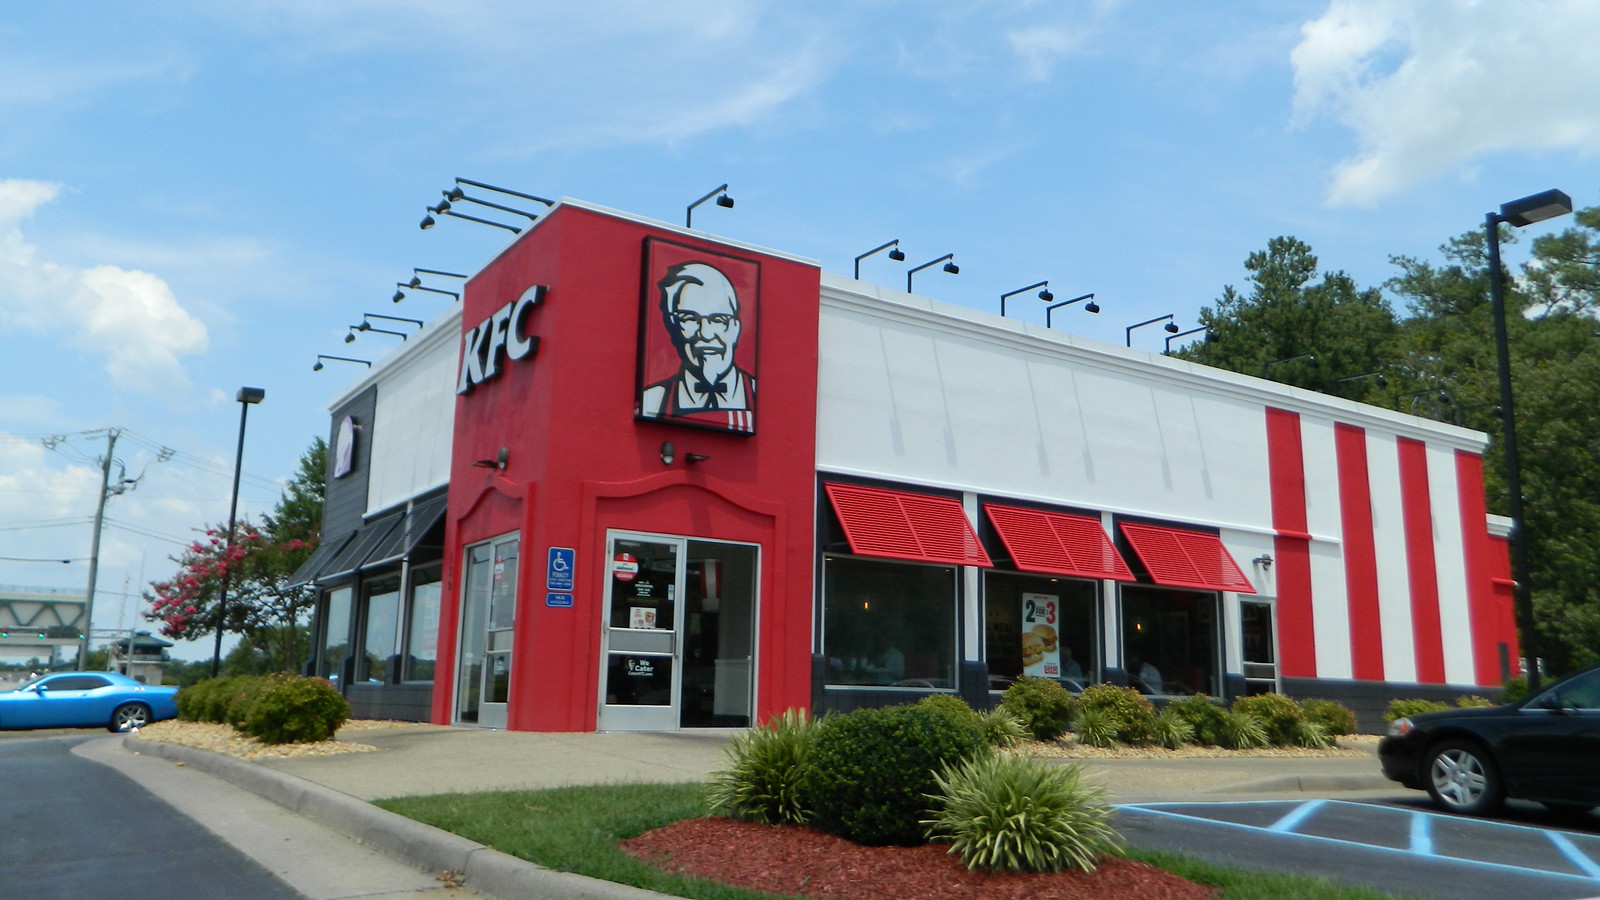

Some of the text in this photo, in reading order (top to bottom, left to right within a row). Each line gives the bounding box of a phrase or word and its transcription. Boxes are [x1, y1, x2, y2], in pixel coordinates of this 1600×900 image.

[456, 285, 540, 395] KFC
[1025, 599, 1036, 623] 2
[1035, 606, 1046, 616] FOR
